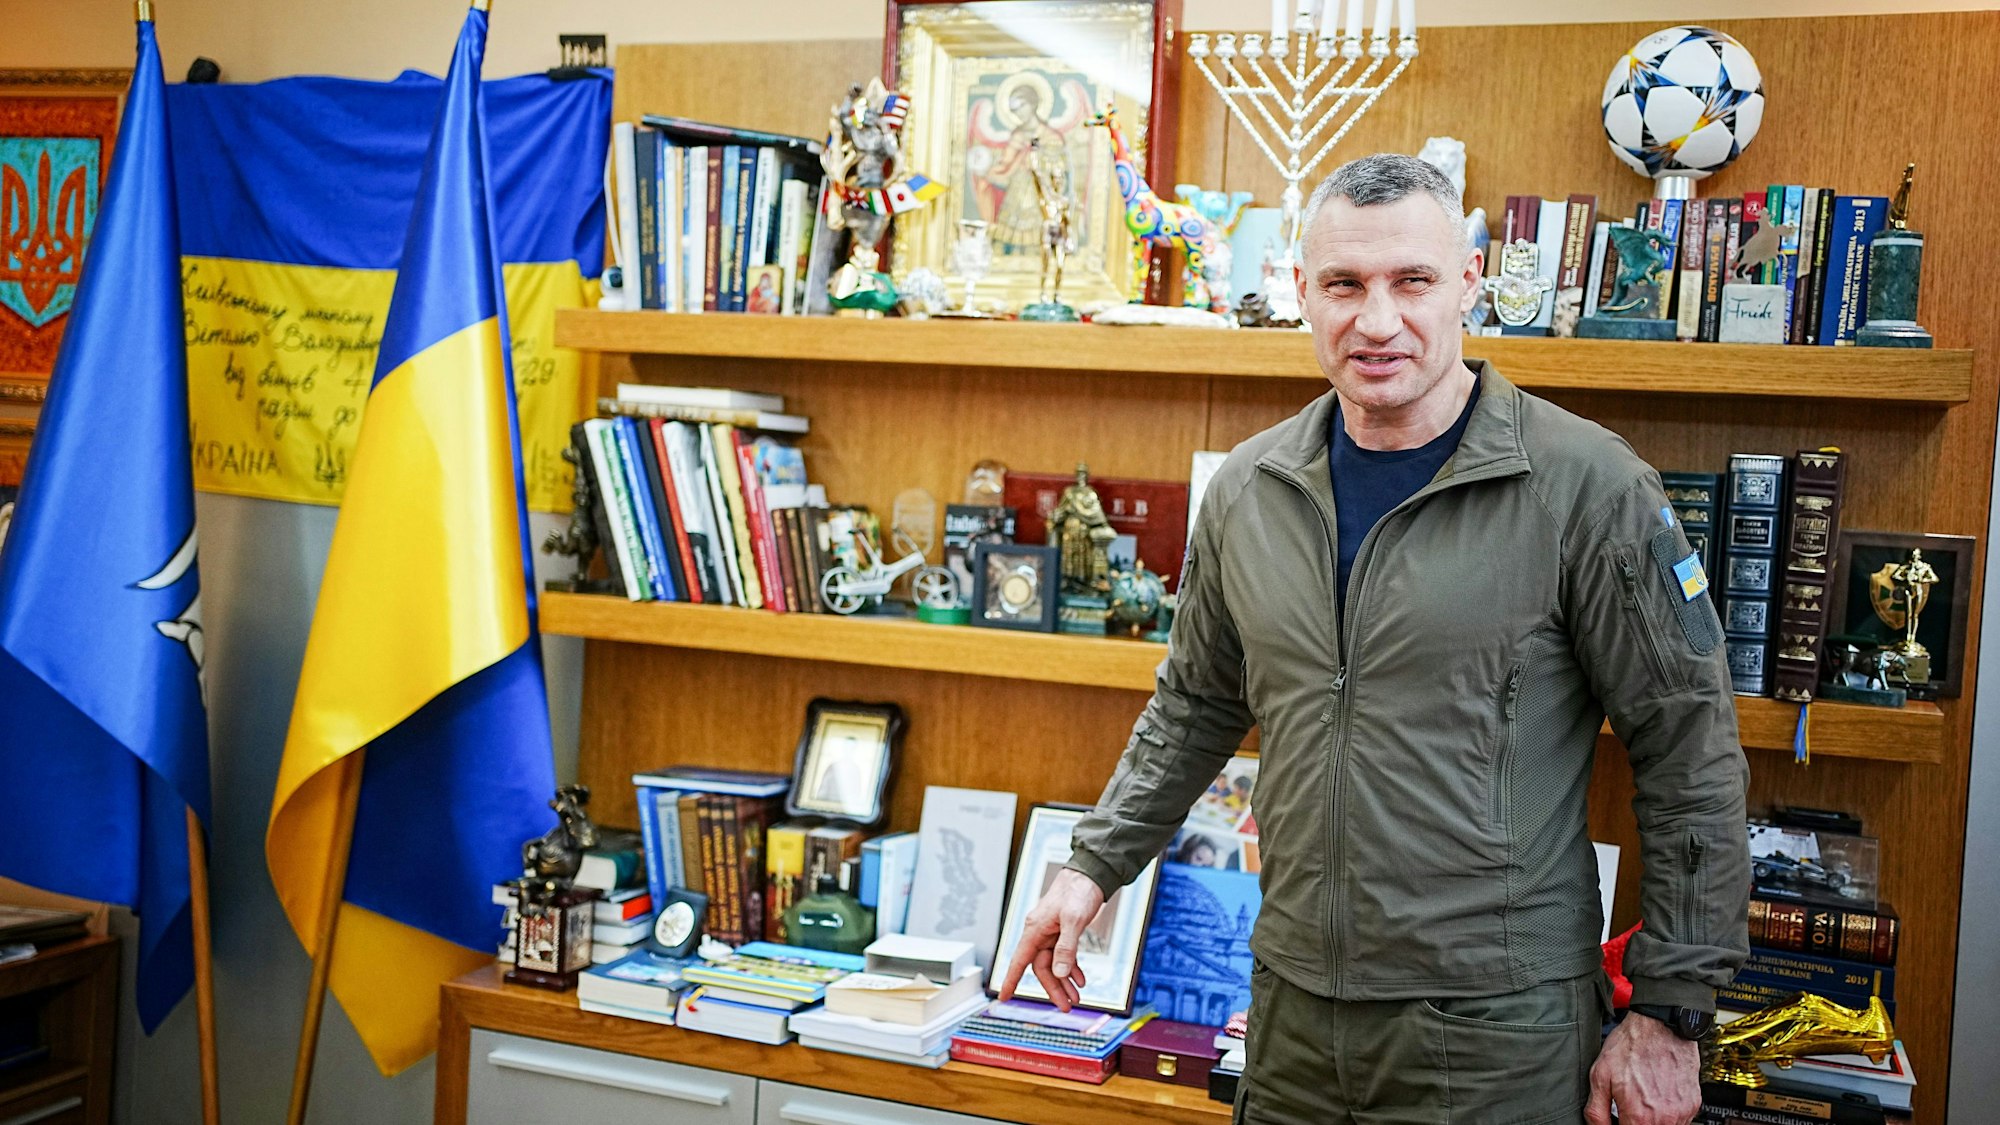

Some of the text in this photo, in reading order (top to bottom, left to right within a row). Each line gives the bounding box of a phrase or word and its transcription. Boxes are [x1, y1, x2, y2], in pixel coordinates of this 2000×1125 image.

[1707, 245, 1719, 302] БУЛГАКОВ
[1838, 209, 1866, 338] УКРАЇНА ДИПЛОМАТИЧНА 2013
[1847, 244, 1865, 330] DIPLOMATIC UKRAINE
[274, 323, 380, 373] Володимир
[1796, 517, 1827, 531] УКРАЇНА
[1743, 962, 1813, 980] MATIC UKRAINE
[1760, 955, 1869, 985] ДИПЛОМАТИЧНА 2019
[1719, 990, 1773, 1005] DIPLOMATIC
[1730, 982, 1757, 993] РАЇНА
[1702, 1103, 1814, 1125] lympic constellation
